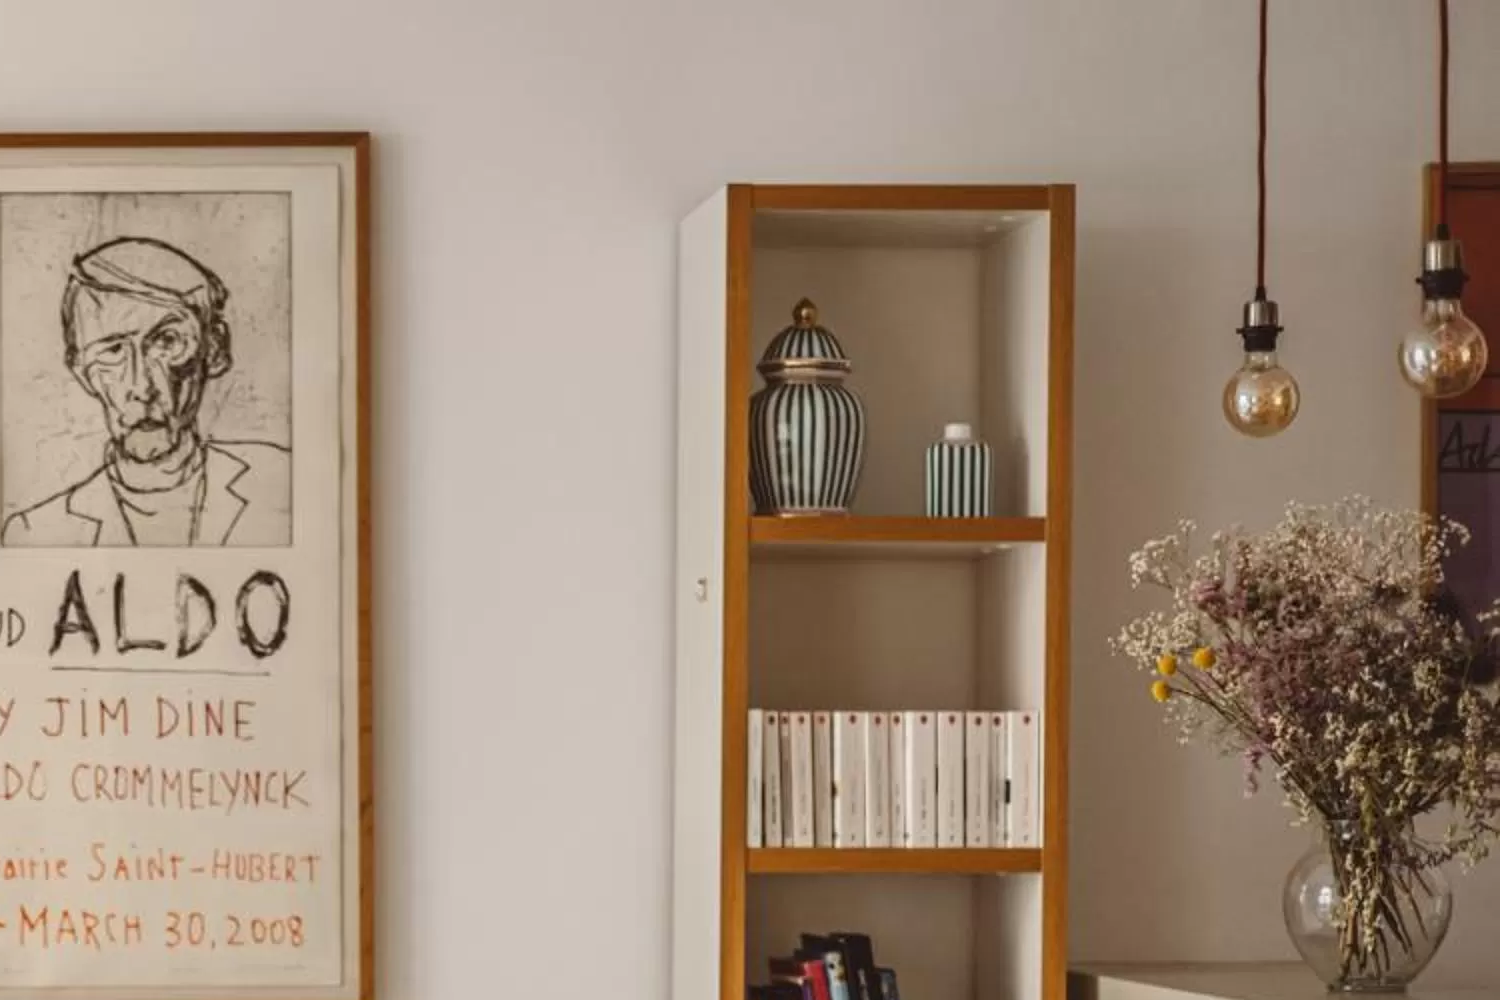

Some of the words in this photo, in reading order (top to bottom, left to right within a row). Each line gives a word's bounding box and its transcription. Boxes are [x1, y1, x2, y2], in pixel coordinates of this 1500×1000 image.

[49, 569, 291, 658] ALDO
[71, 762, 311, 817] CROMMELYNCK
[18, 903, 144, 950] MARCH
